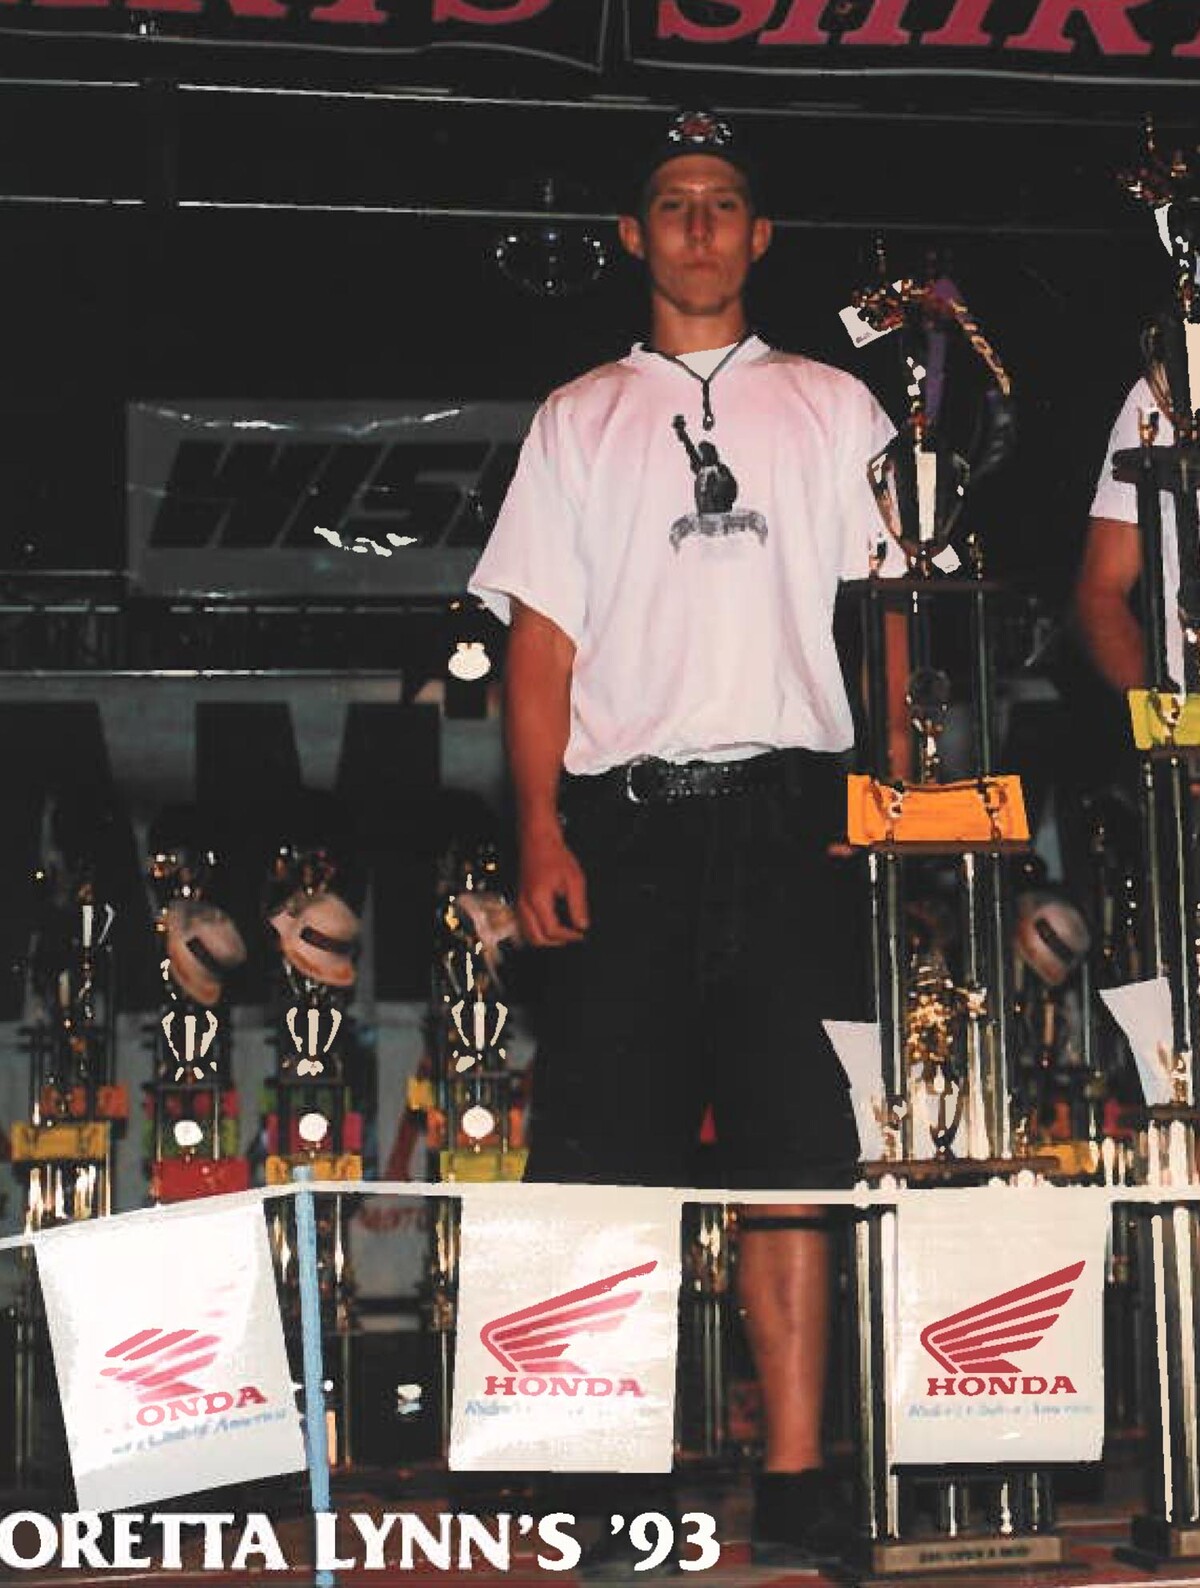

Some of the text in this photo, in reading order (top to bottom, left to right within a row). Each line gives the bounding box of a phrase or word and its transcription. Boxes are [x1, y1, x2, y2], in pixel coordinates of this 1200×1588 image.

[484, 1375, 647, 1397] HONDA
[927, 1375, 1078, 1396] HONDA
[122, 1386, 267, 1428] ONDA
